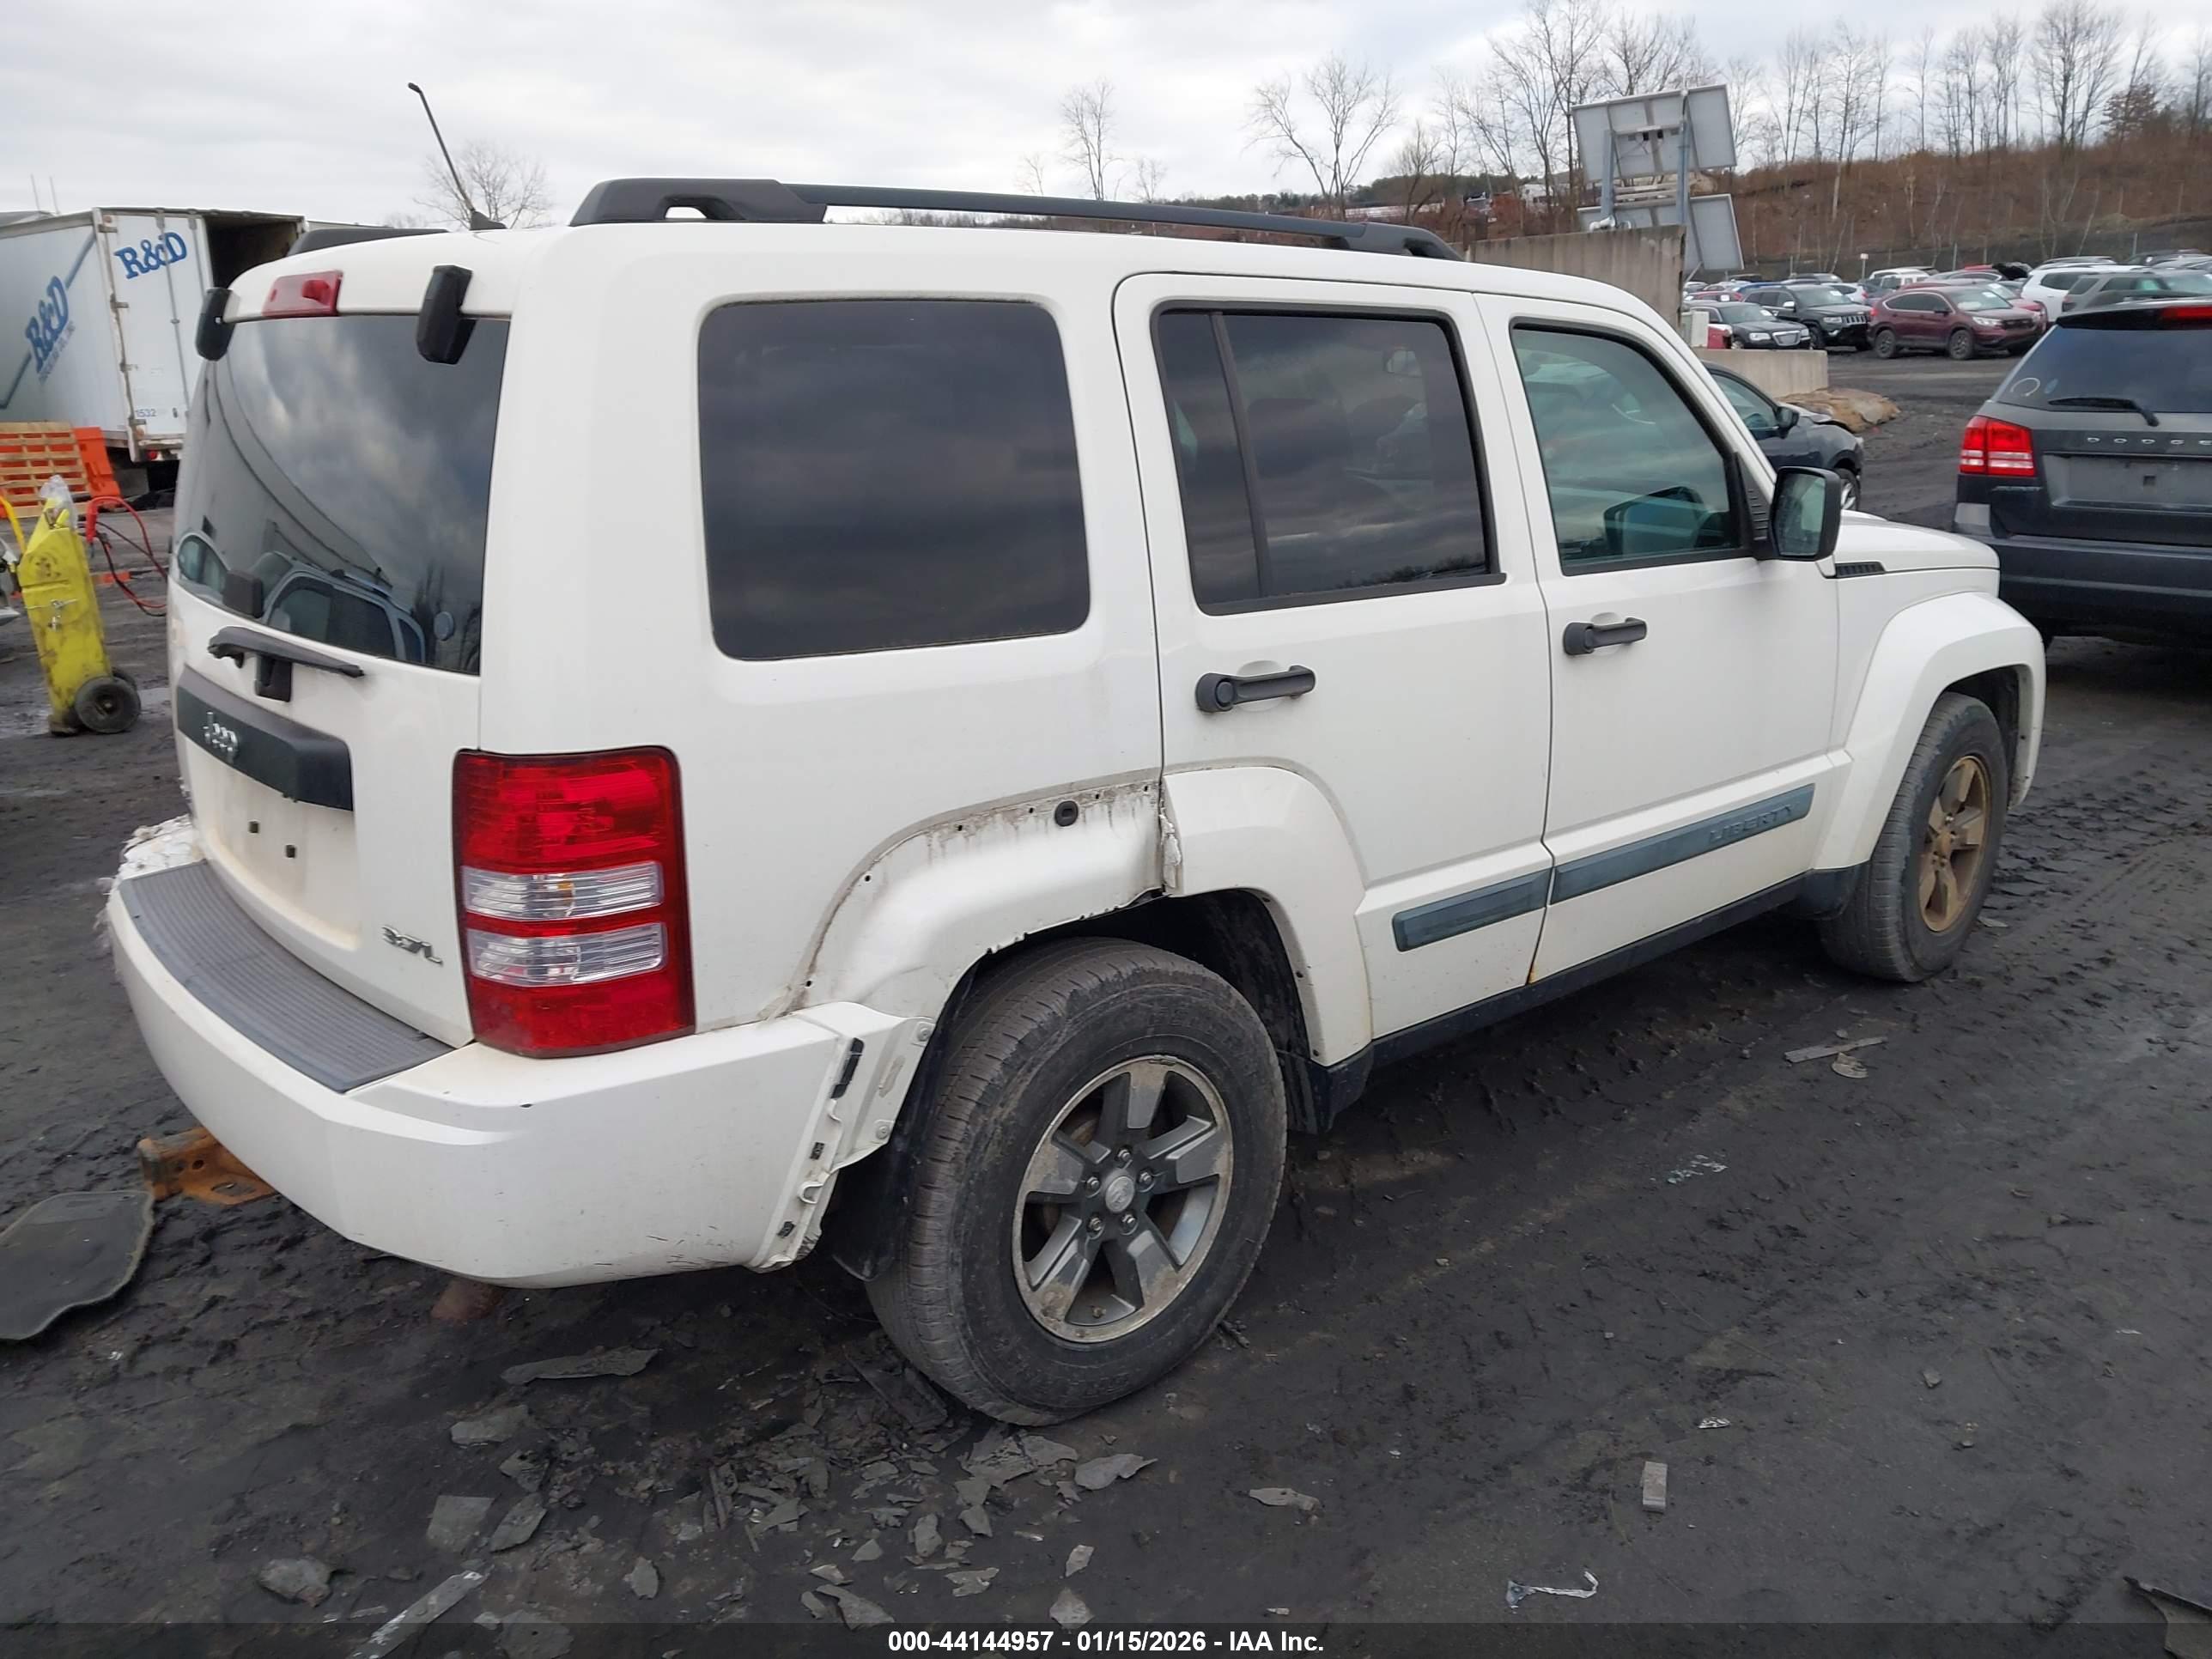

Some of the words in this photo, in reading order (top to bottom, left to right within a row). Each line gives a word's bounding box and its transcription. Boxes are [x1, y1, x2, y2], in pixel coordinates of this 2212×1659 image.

[113, 231, 187, 280] R&D
[25, 275, 69, 374] R&D
[1709, 805, 1792, 842] LIBERTY
